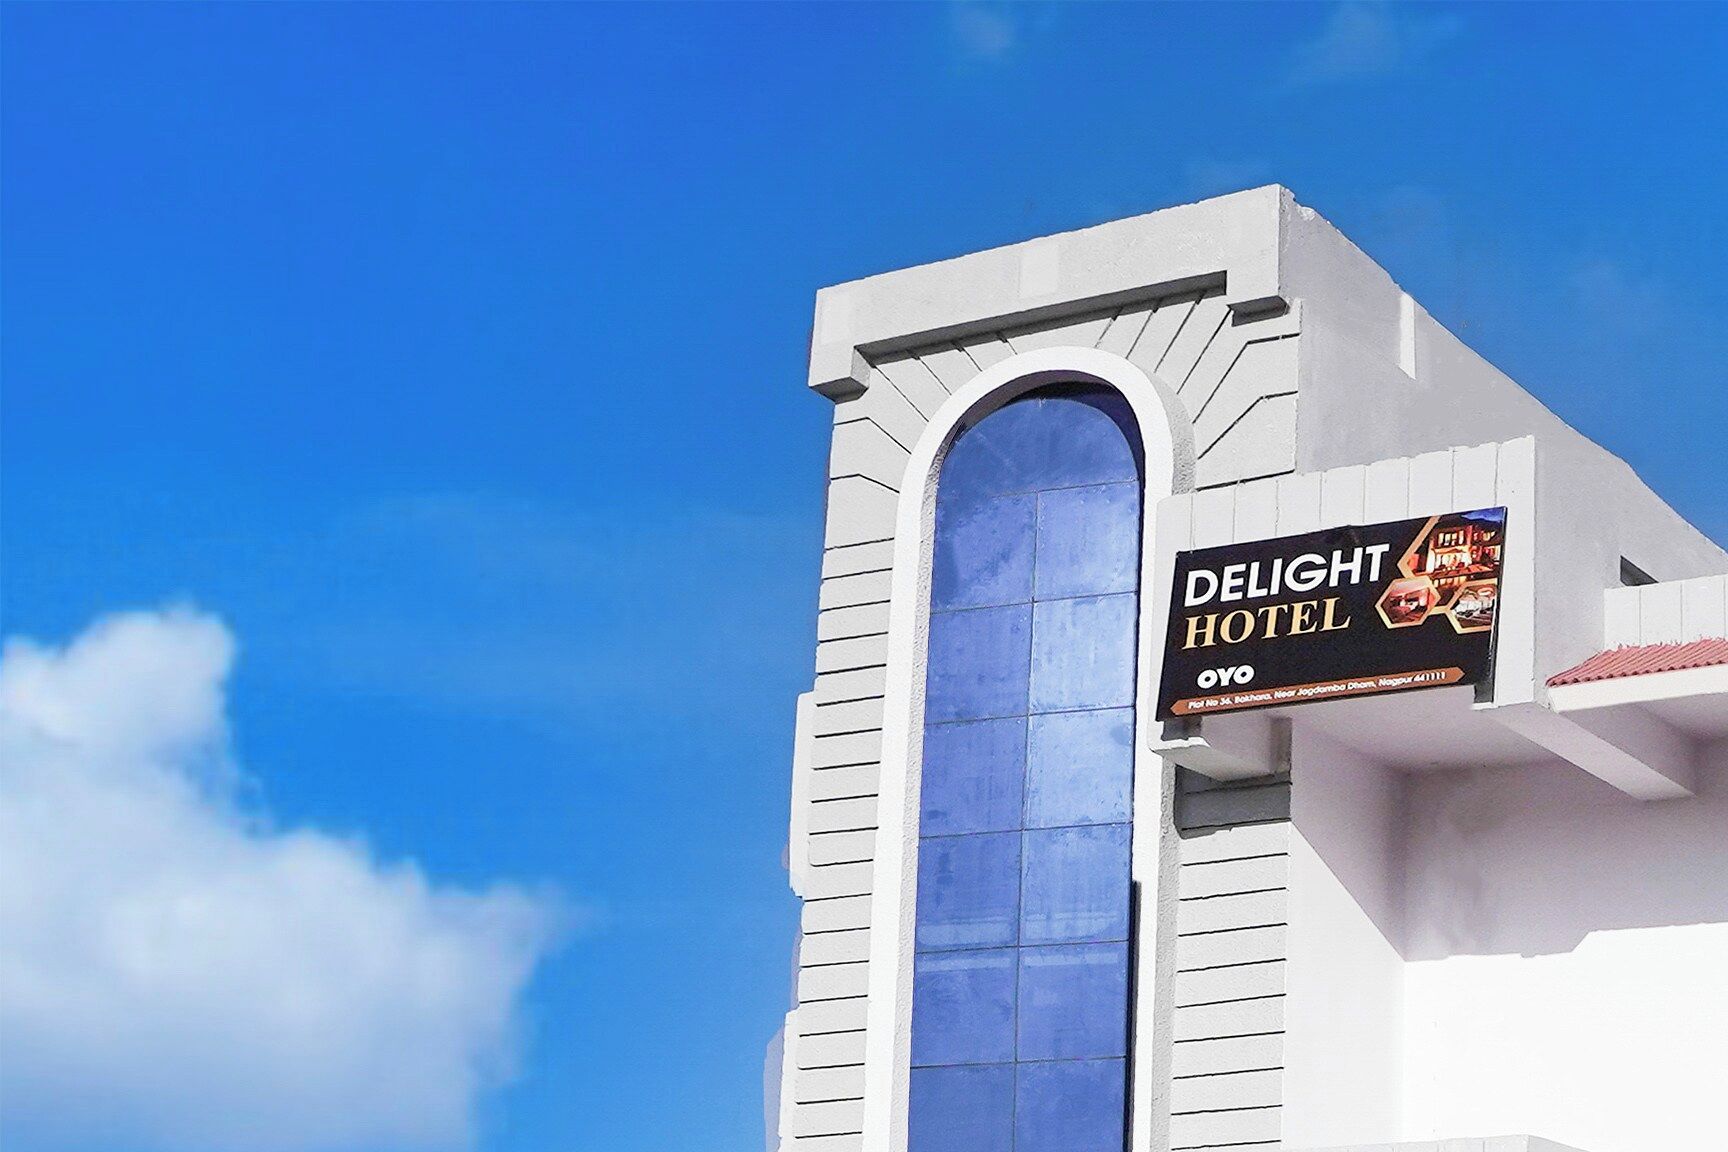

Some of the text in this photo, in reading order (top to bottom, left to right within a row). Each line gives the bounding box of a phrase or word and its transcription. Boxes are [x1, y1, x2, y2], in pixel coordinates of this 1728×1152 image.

[1184, 543, 1390, 608] DELIGHT
[1181, 597, 1351, 650] HOTEL
[1197, 664, 1255, 689] OYO
[1205, 697, 1219, 708] No
[1274, 690, 1297, 700] Near
[1378, 676, 1413, 688] Nagpur
